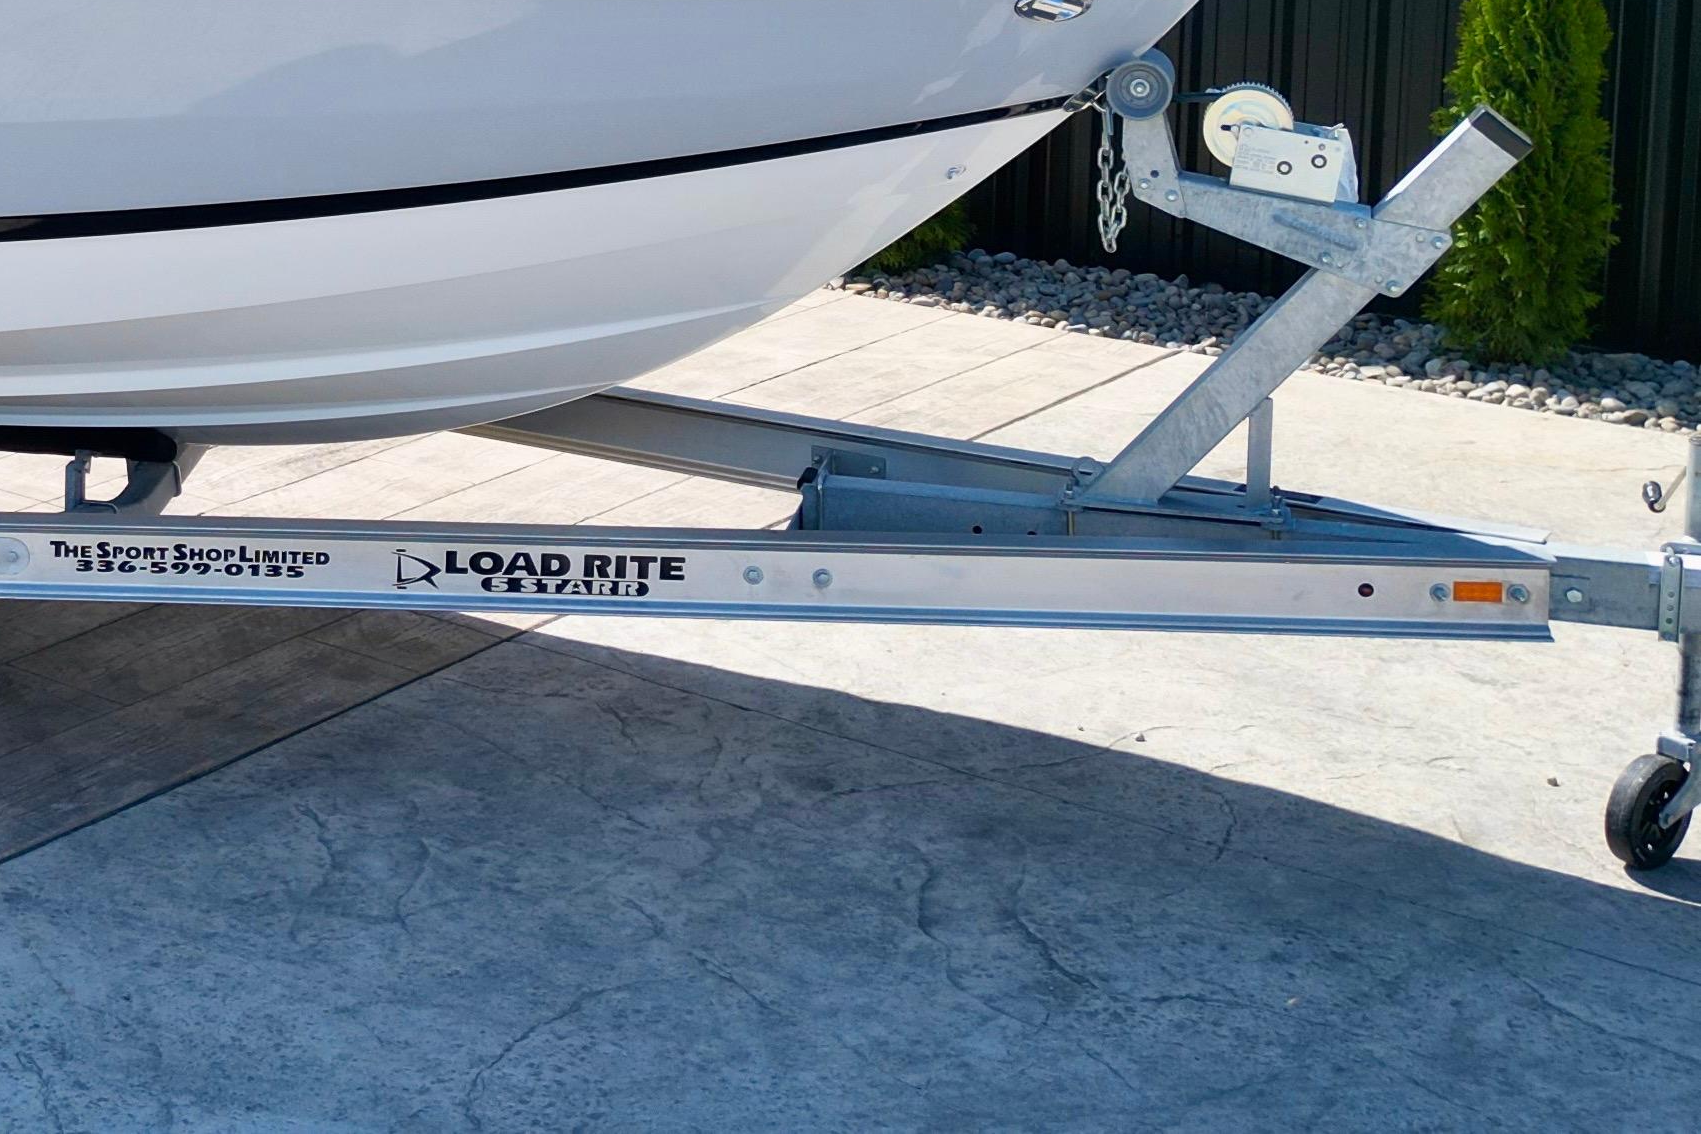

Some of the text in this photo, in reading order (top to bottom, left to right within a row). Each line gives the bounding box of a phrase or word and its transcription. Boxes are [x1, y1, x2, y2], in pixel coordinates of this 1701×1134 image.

[75, 559, 305, 579] 336-599-0135
[445, 550, 686, 581] LOAD RITE
[489, 577, 642, 597] 5 STARR
